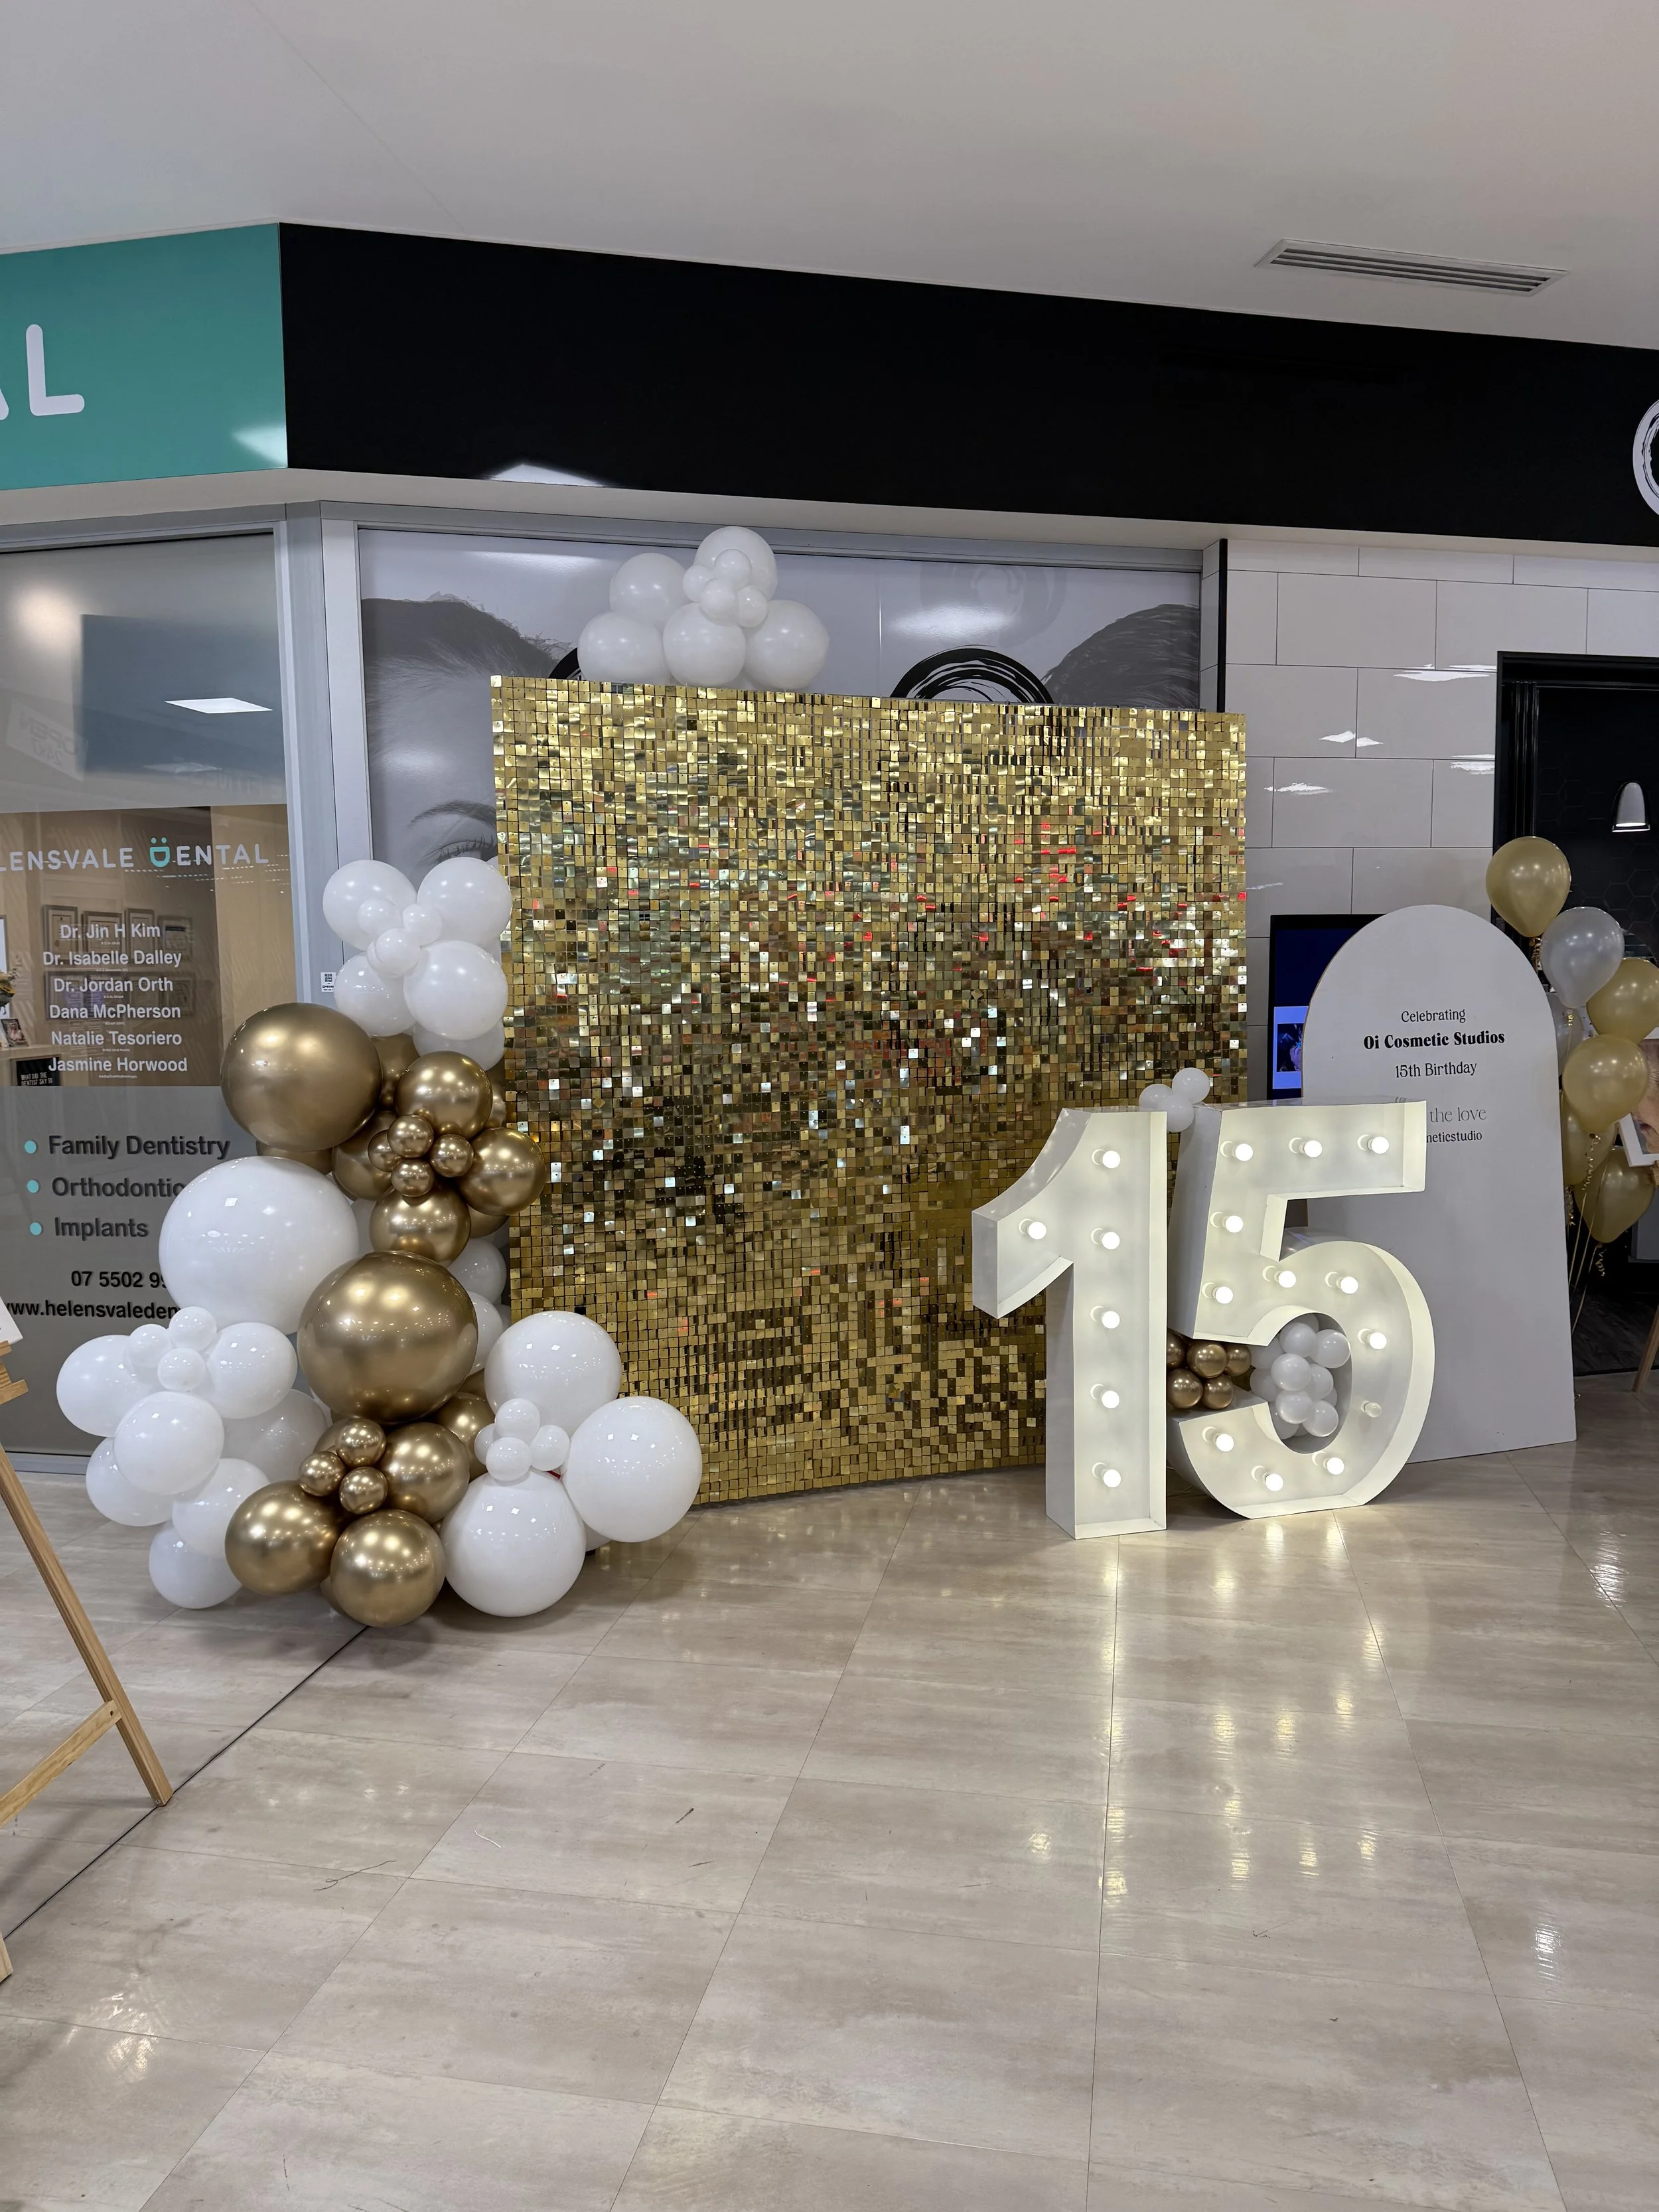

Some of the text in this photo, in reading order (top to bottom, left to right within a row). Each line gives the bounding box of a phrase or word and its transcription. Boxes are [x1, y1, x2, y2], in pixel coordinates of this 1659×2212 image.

[0, 324, 85, 421] L
[0, 838, 269, 871] ENSVALE DENTAL
[60, 923, 161, 938] Dr. Jin H Kim
[42, 950, 182, 968] Dr. Isabelle Dalley
[54, 977, 173, 992] Dr. Jordan Orth
[49, 1004, 180, 1019] Dana McPherson
[1401, 1009, 1466, 1023] Celebrating
[51, 1031, 182, 1045] Natalie Tesoriero
[1364, 1030, 1505, 1049] Oi Cosmetic Studios
[48, 1057, 188, 1072] Jasmine Horwood
[1396, 1061, 1477, 1078] 15th Birthday
[1430, 1107, 1487, 1122] the love
[49, 1136, 230, 1160] Family Dentistry
[54, 1217, 149, 1241] Implants
[71, 1270, 93, 1287] 07
[99, 1271, 143, 1288] 5502
[6, 1299, 180, 1319] ww.helensvaleden
[972, 1100, 1435, 1540] 15
